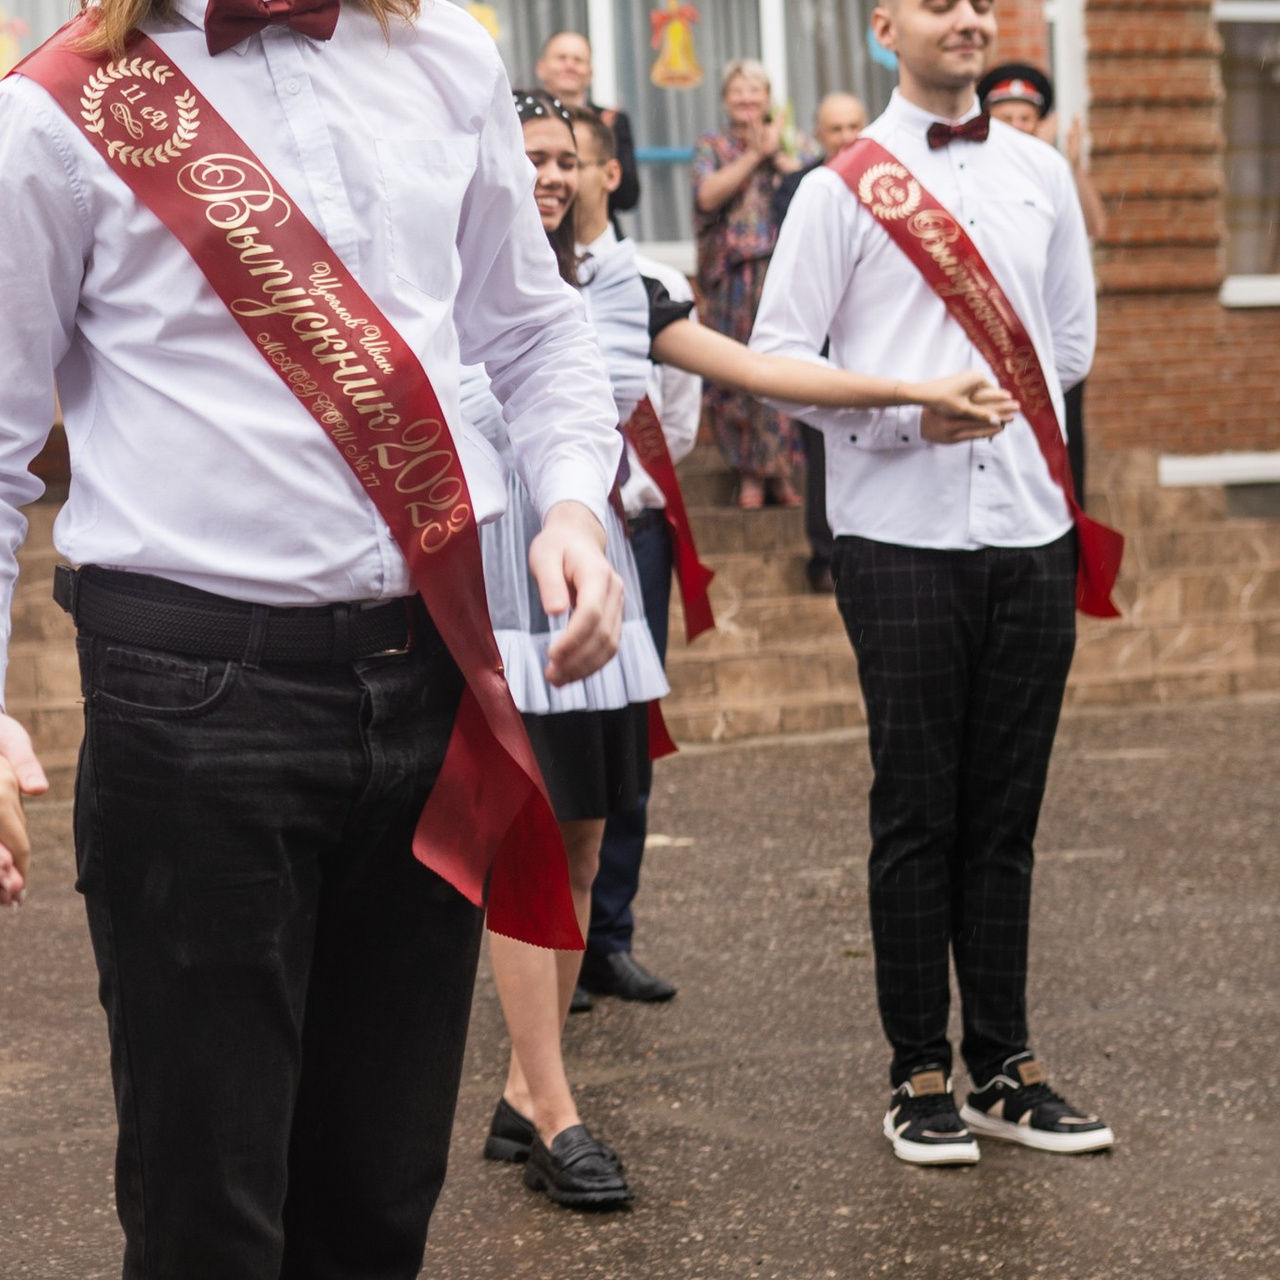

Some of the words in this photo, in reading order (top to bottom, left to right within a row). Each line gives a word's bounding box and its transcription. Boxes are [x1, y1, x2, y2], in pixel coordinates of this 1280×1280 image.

[120, 83, 147, 105] 11
[177, 153, 400, 432] Выпускник
[369, 418, 470, 554] 2023
[359, 324, 394, 374] Иван
[362, 472, 381, 487] 77
